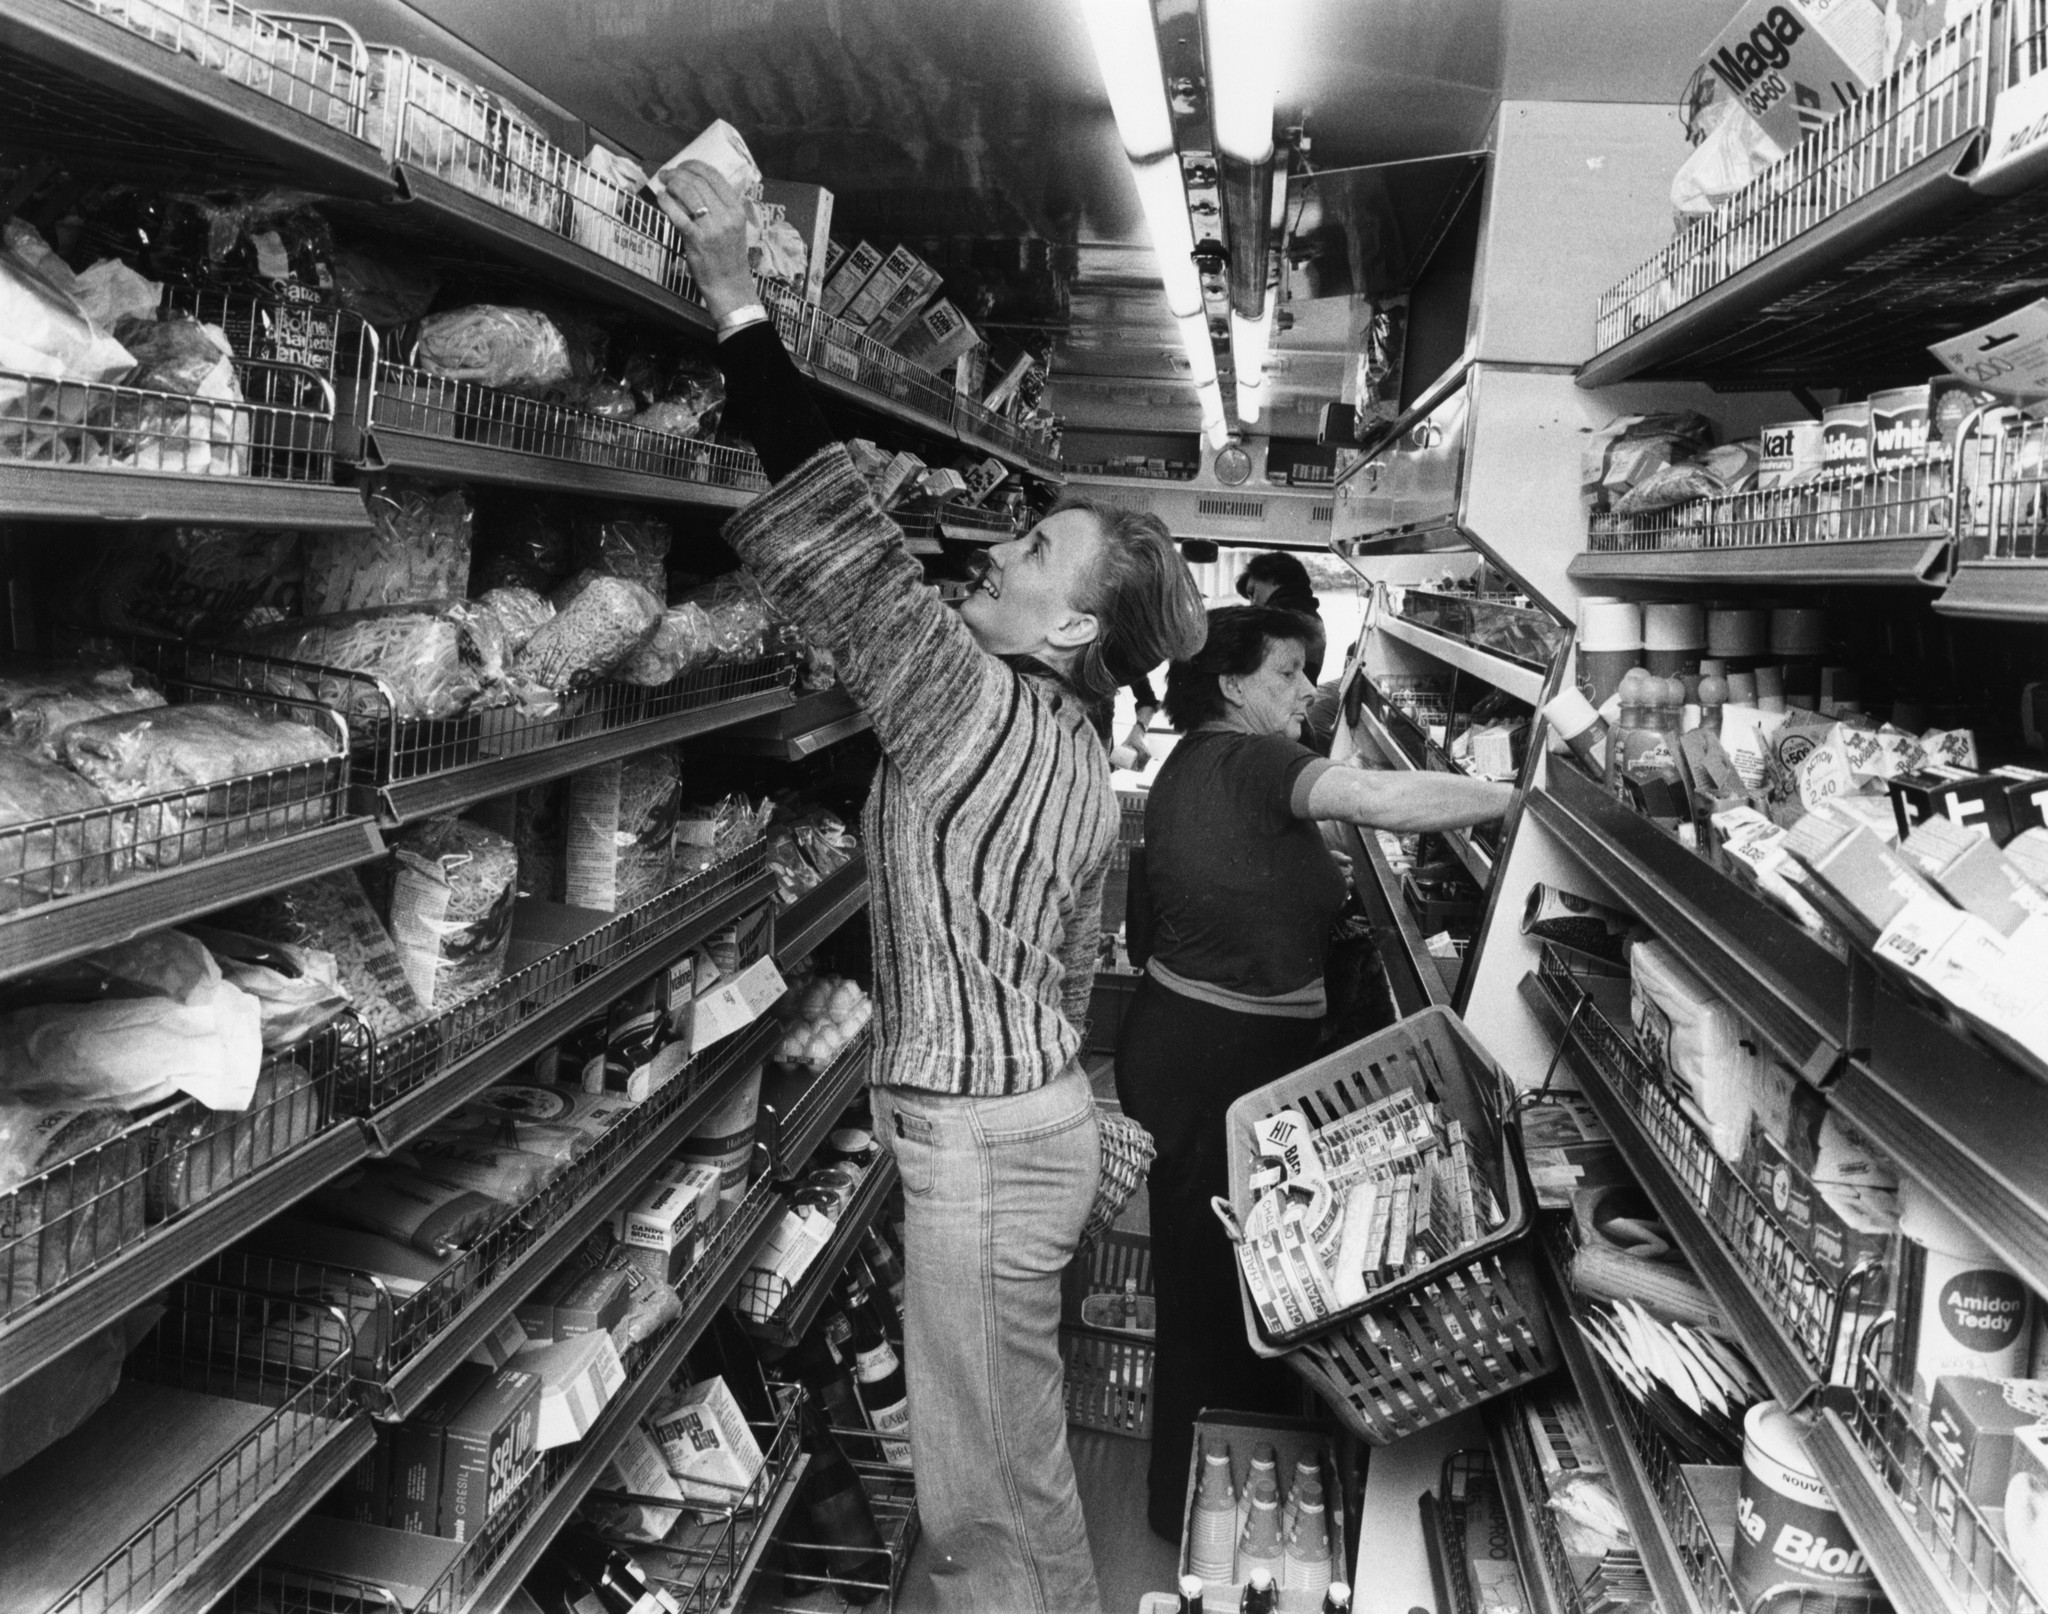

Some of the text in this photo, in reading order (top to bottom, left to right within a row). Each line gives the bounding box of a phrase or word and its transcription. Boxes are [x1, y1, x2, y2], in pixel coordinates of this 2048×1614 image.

[1709, 6, 1805, 96] Maga
[853, 250, 875, 271] RICE
[889, 255, 911, 275] RICE
[933, 310, 953, 330] CORN
[1762, 430, 1795, 458] kat
[1806, 750, 1834, 777] ACTION
[1809, 780, 1836, 805] 2.40
[1269, 1120, 1298, 1143] HIT
[1241, 1244, 1264, 1292] CHALET
[1270, 1267, 1304, 1327] CHALET
[1296, 1260, 1327, 1317] CHALET
[1947, 1290, 2020, 1312] Amidon
[1954, 1308, 2013, 1333] Teddy
[652, 1411, 704, 1446] happy
[690, 1428, 720, 1452] day
[455, 1470, 469, 1516] GRESIL
